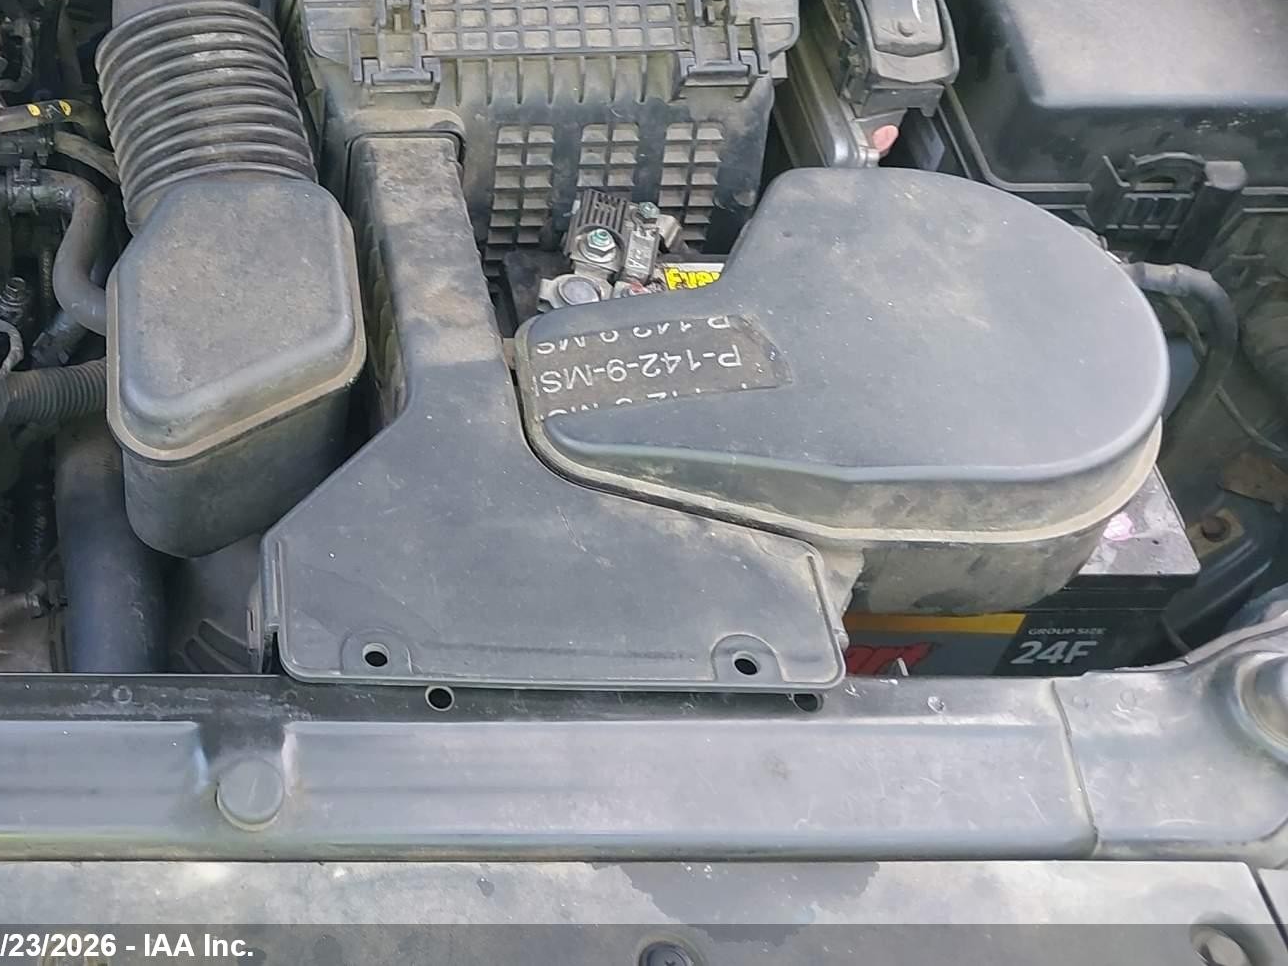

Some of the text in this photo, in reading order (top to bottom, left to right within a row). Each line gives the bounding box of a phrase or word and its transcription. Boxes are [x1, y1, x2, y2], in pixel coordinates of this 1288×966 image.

[1028, 627, 1106, 635] GROUP SIZE
[1010, 640, 1098, 665] 24F
